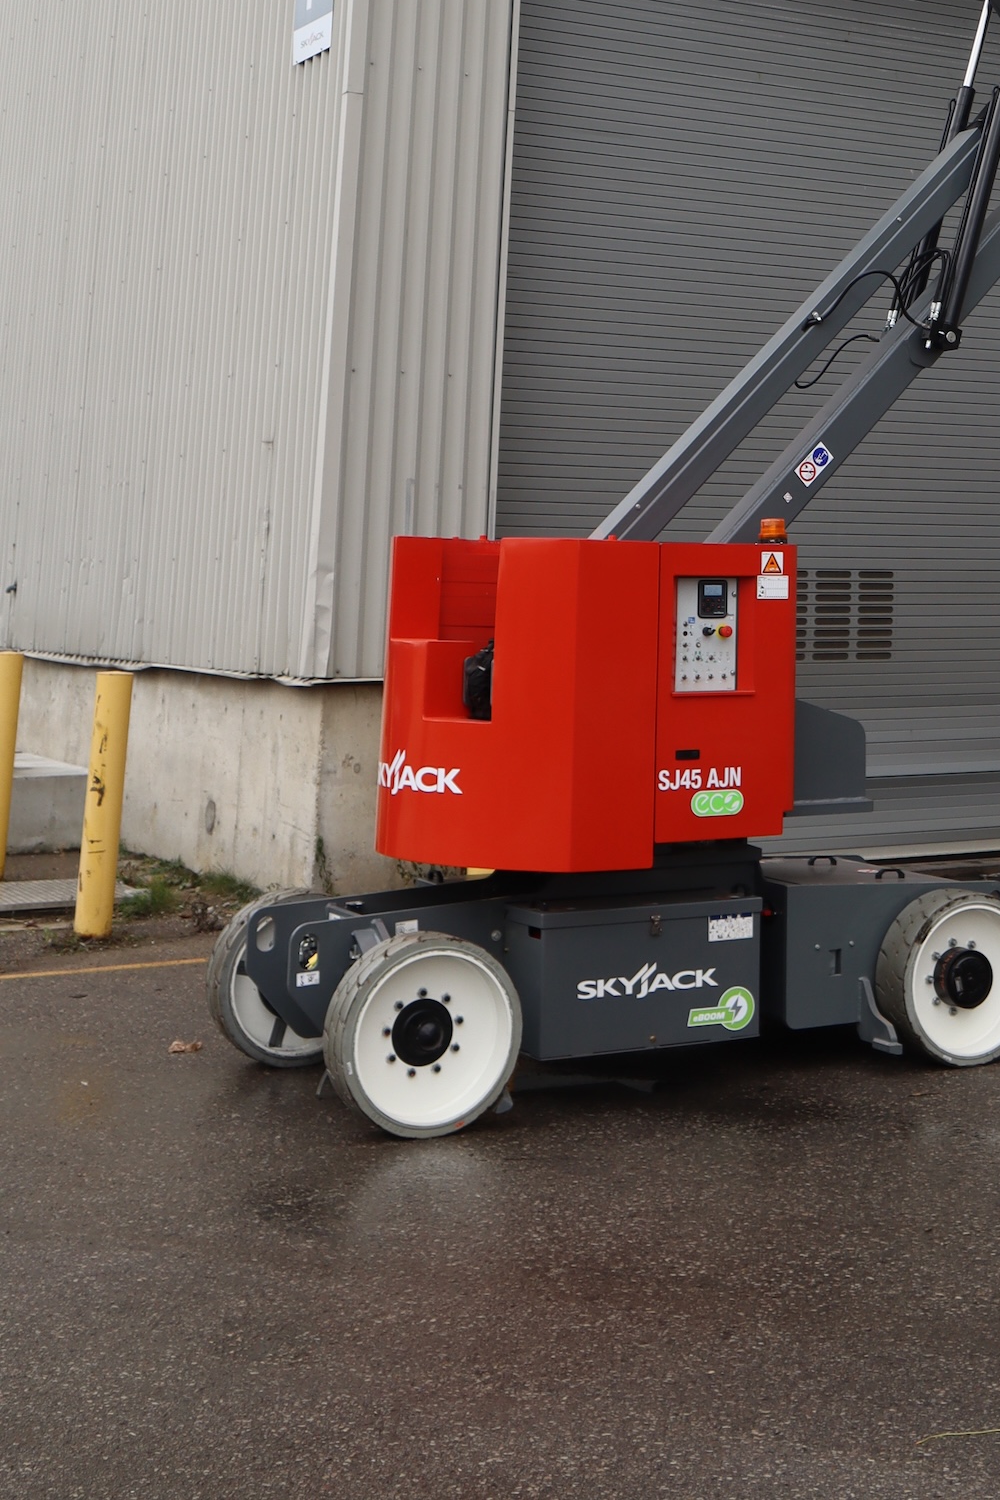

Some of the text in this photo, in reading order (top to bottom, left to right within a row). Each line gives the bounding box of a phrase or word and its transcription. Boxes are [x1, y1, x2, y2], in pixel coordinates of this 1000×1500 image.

[377, 748, 464, 796] KYJACK
[658, 766, 742, 791] SJ45 AJN
[694, 792, 741, 814] eco
[576, 961, 719, 1000] SKYJACK
[692, 1011, 726, 1023] eBOOM
